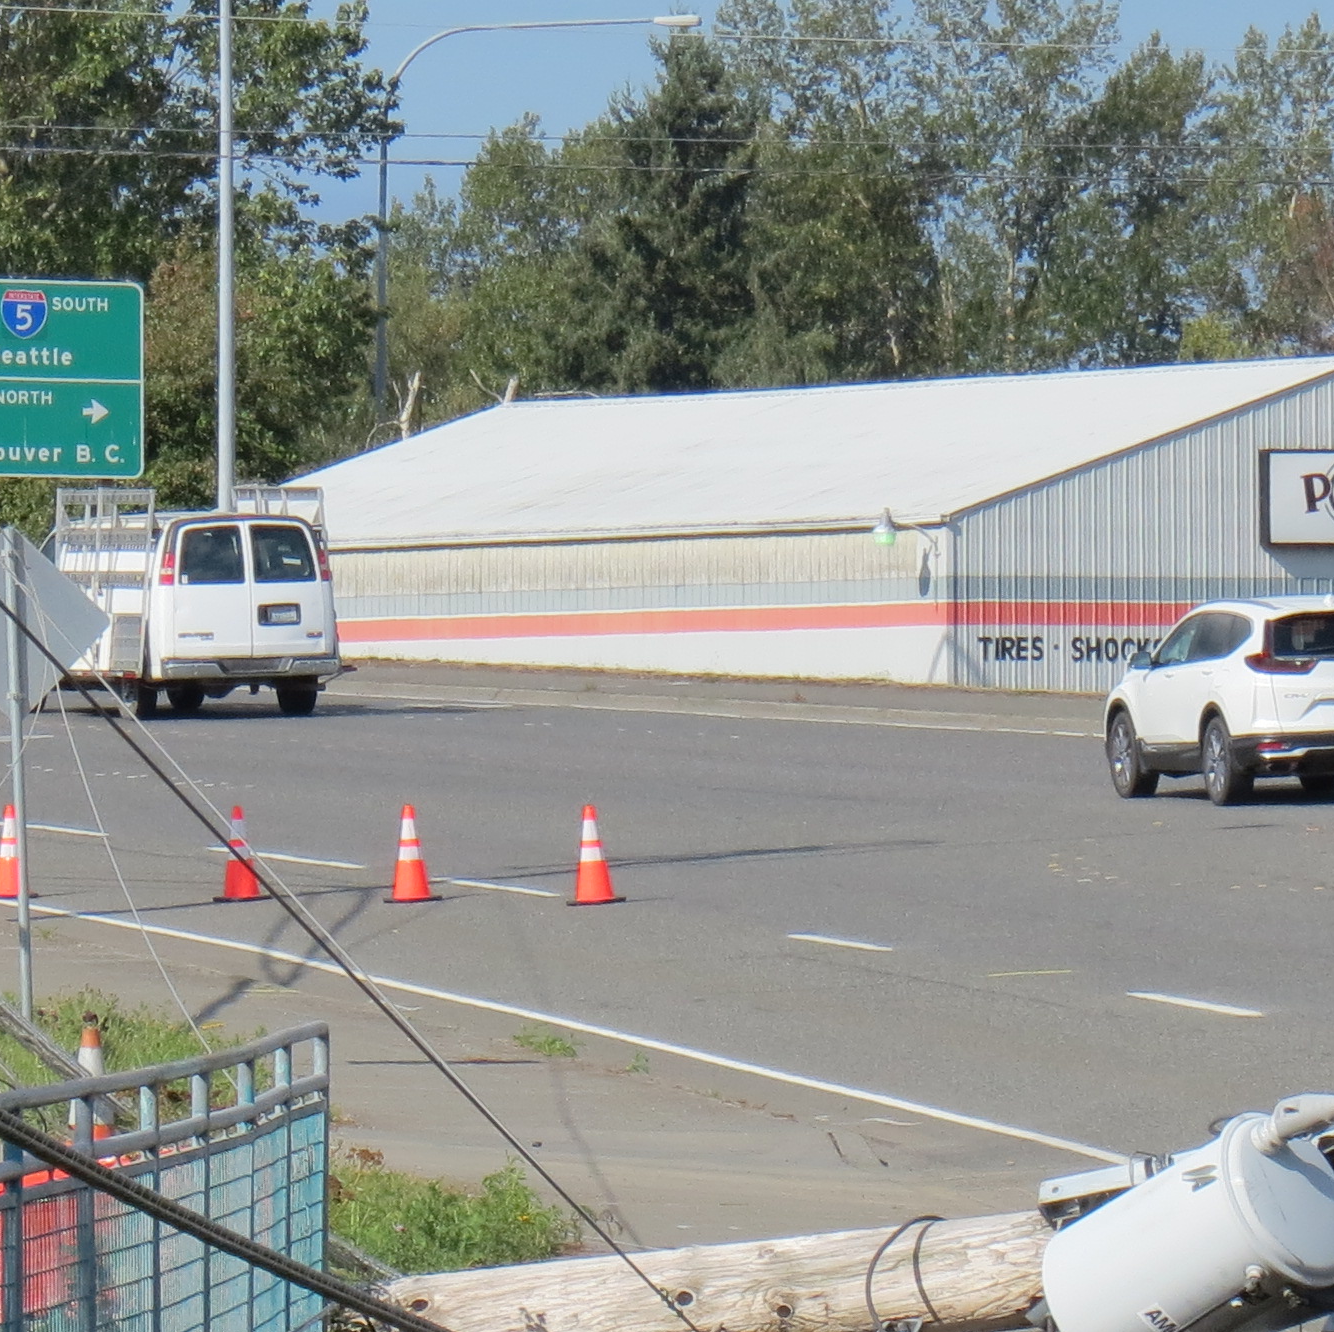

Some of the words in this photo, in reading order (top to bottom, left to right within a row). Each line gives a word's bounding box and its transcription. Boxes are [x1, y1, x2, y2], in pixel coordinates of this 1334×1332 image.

[15, 304, 33, 331] 5
[51, 296, 109, 312] SOUTH
[76, 444, 96, 463] B.
[105, 445, 125, 464] C.
[977, 636, 1044, 662] TIRES
